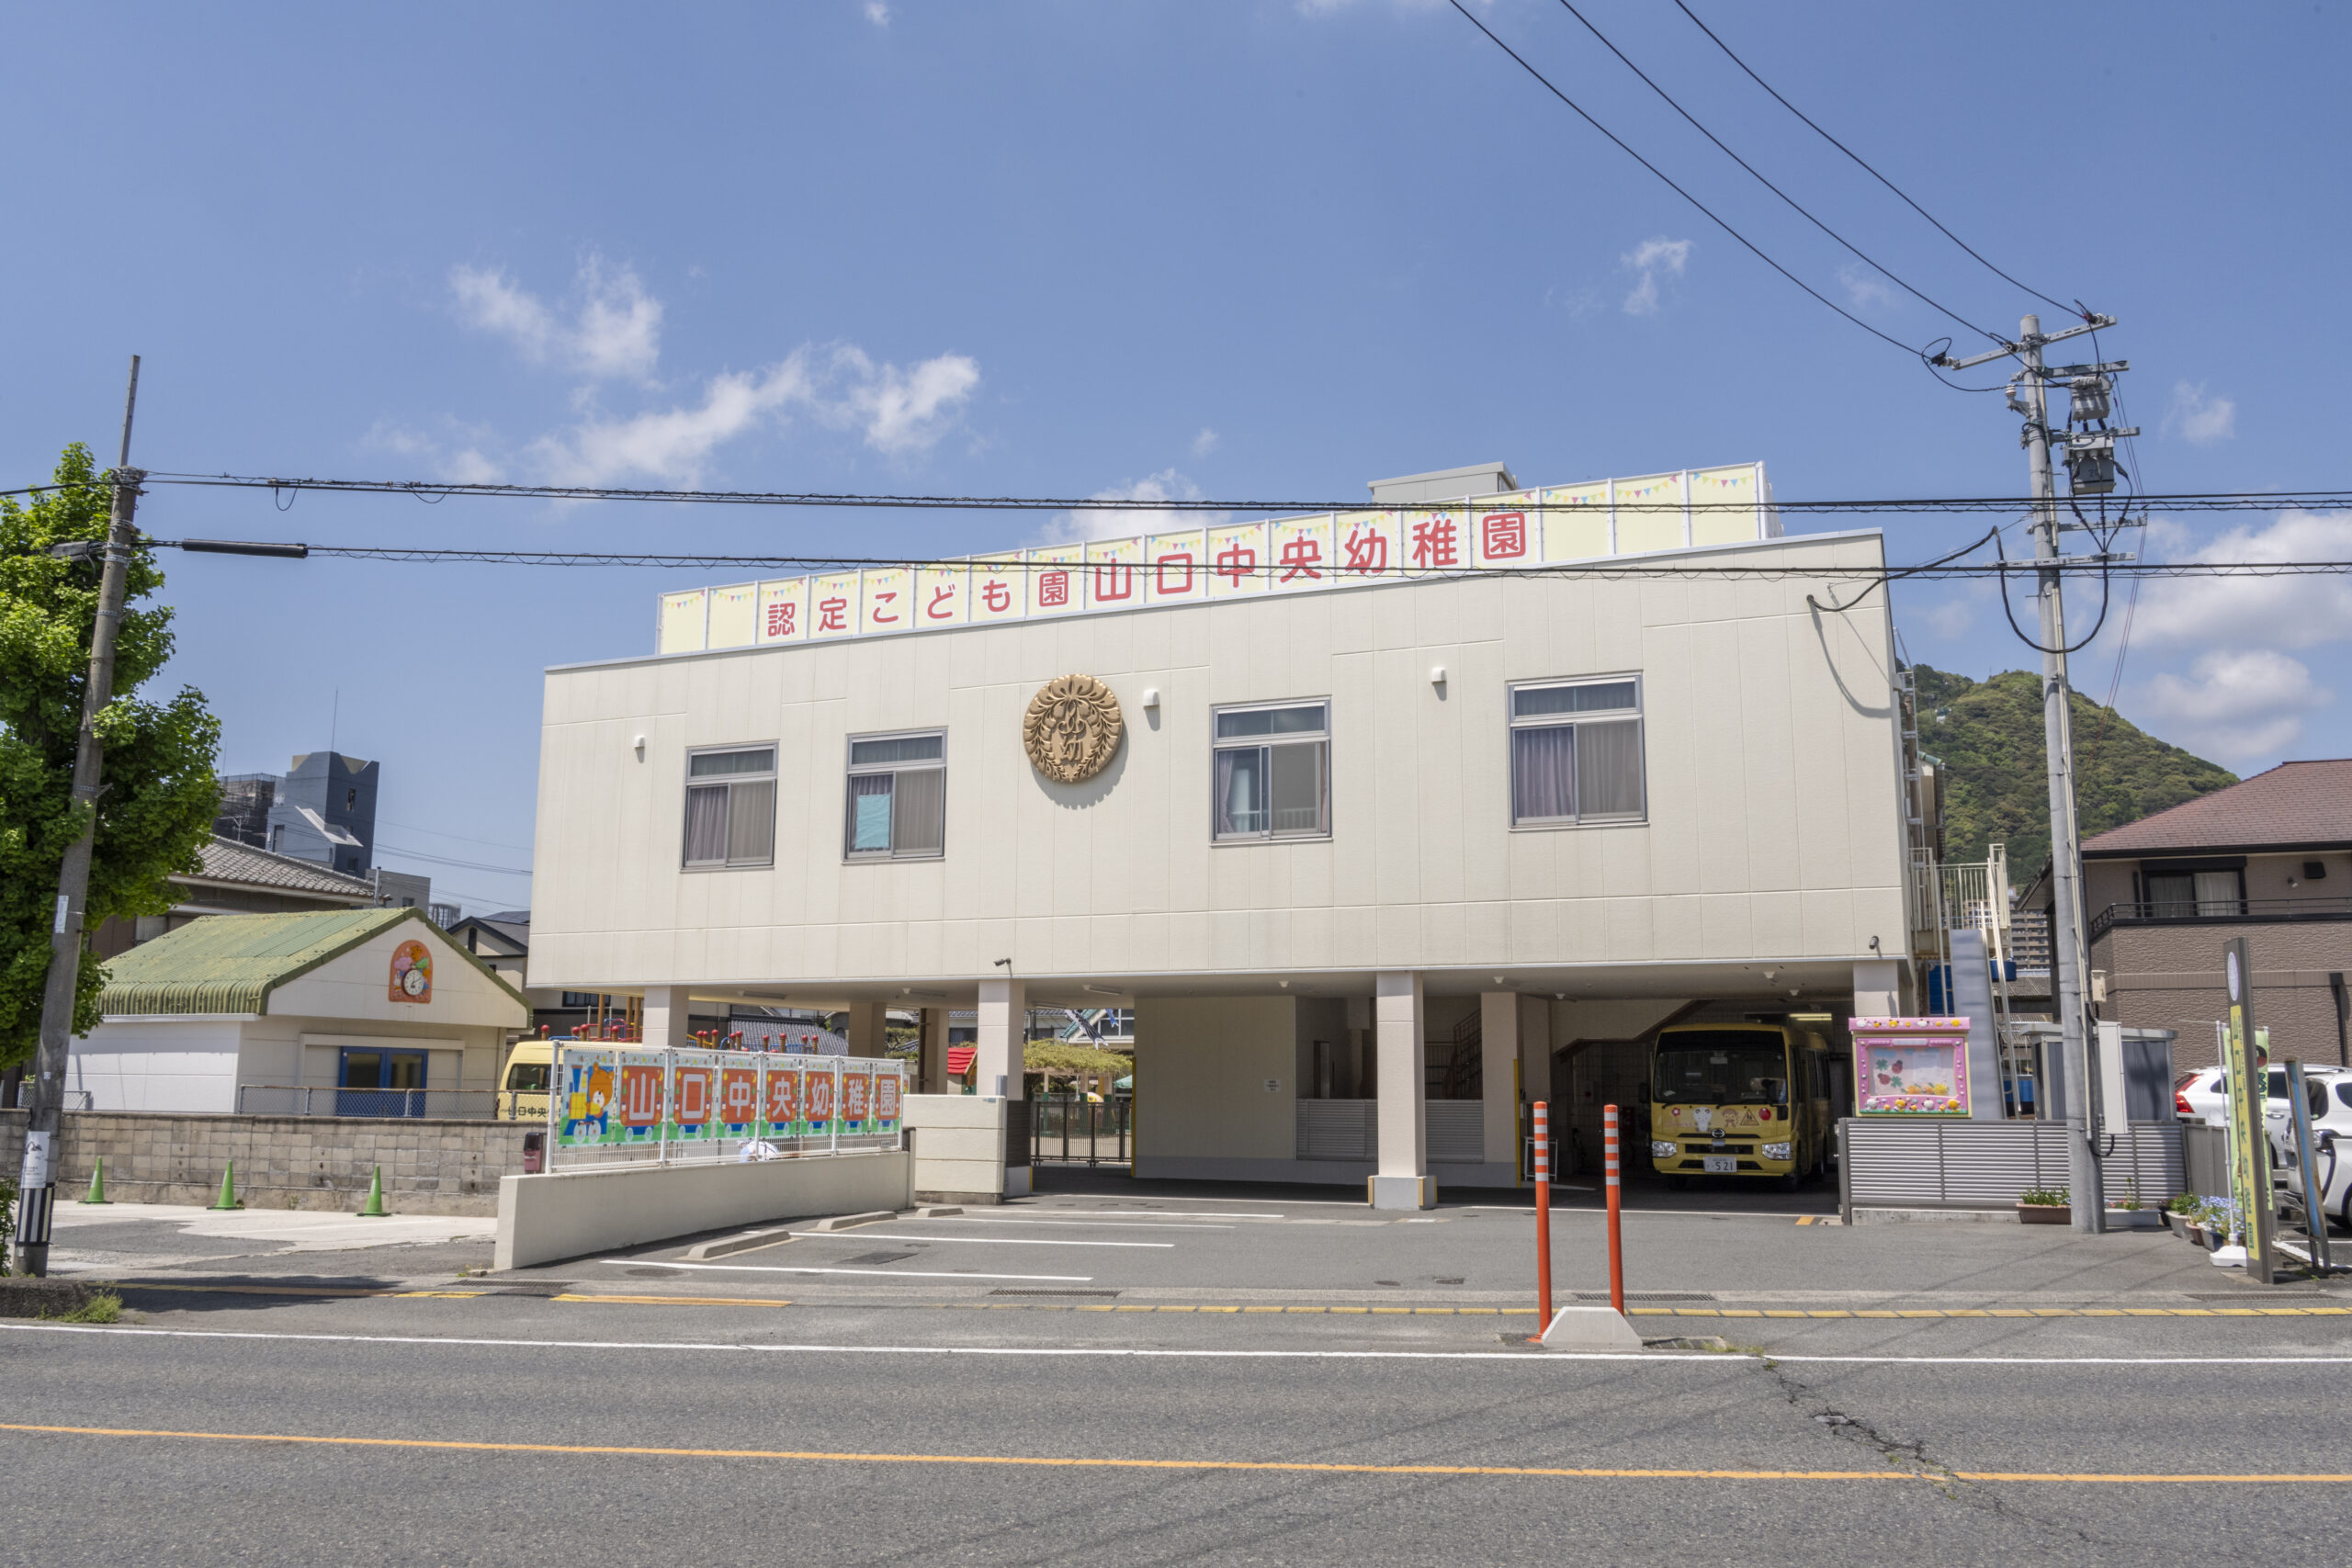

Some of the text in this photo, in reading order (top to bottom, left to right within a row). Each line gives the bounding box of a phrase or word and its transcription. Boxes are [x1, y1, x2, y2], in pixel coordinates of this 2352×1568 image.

[767, 511, 1526, 637] 認定こども園山口中央幼稚園
[628, 1072, 897, 1121] 山口中央幼稚園
